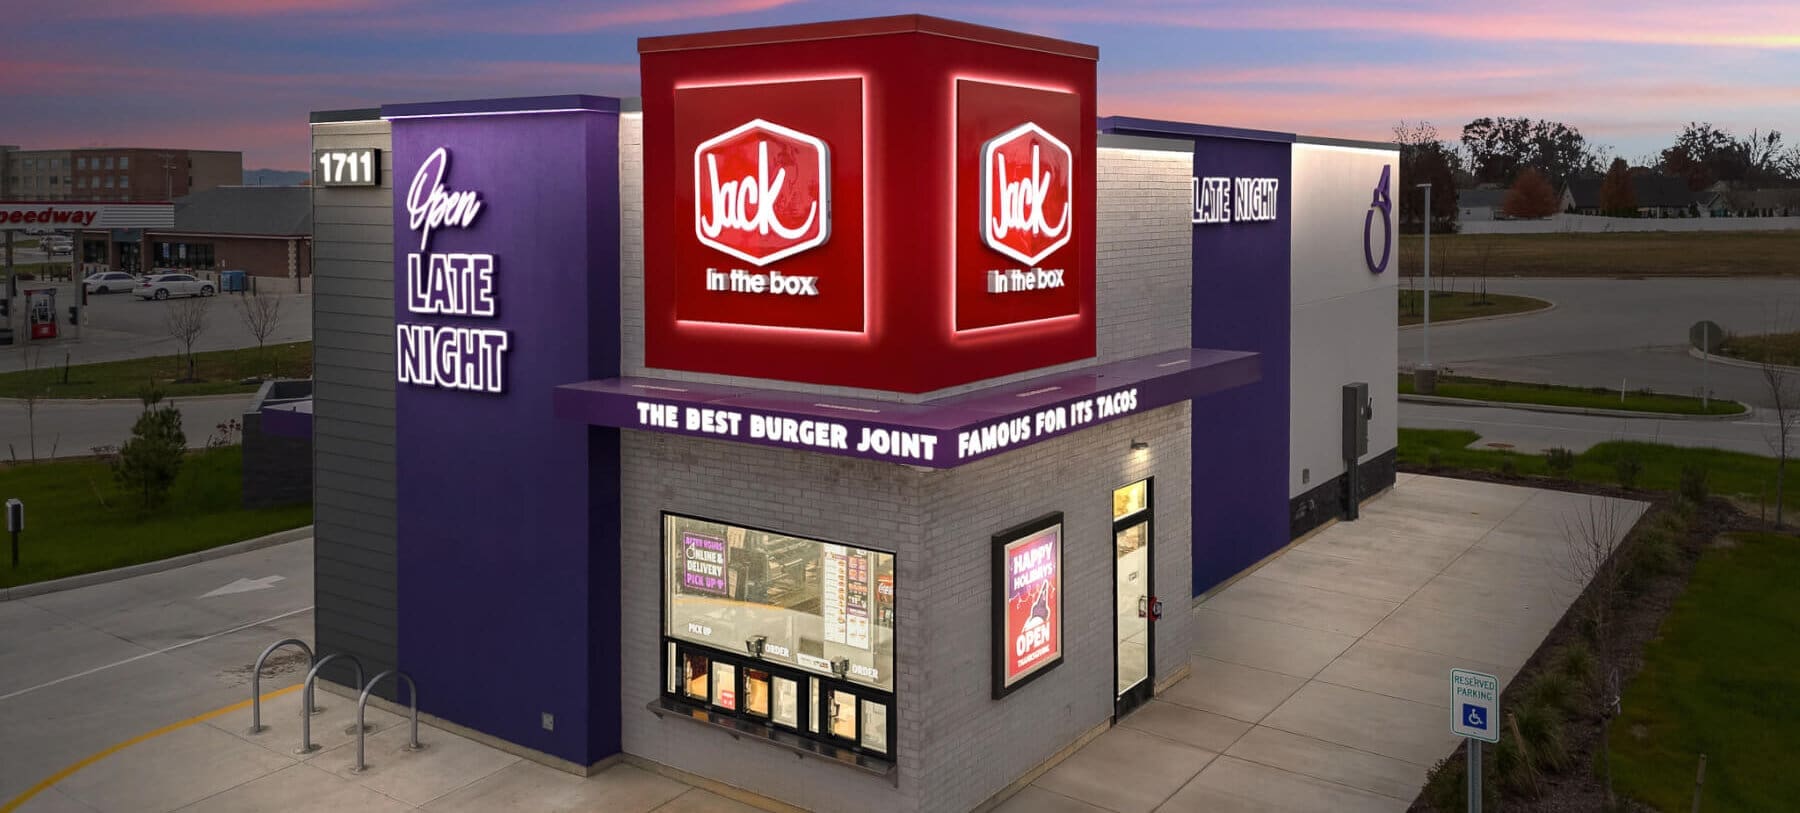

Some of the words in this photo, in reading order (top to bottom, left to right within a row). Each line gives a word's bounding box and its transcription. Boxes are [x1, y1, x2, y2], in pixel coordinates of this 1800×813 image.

[319, 151, 371, 183] 1711
[406, 147, 481, 251] Open
[700, 140, 817, 240] Jack
[992, 144, 1069, 240] Jack
[1191, 177, 1231, 223] LATE
[1234, 177, 1279, 222] NIGHT
[407, 253, 495, 316] LATE
[730, 269, 768, 293] the
[769, 270, 819, 295] box
[1009, 269, 1035, 291] the
[1035, 268, 1065, 289] box
[396, 324, 507, 393] NIGHT
[636, 401, 679, 428] THE
[685, 408, 742, 435] BEST
[750, 414, 849, 450] BURGER
[857, 428, 938, 461] JOINT
[958, 415, 1031, 459] FAMOUS
[1035, 407, 1067, 437] FOR
[1070, 399, 1093, 427] ITS
[1096, 388, 1138, 419] TACOS
[687, 560, 722, 577] DELIVERY
[1013, 542, 1052, 573] HAPPY
[687, 572, 704, 587] PICK
[705, 577, 717, 588] UP
[1014, 563, 1052, 589] HOLIDAYS
[688, 623, 703, 634] PICK
[703, 627, 712, 636] UP
[1016, 622, 1050, 656] OPEN
[765, 643, 790, 658] ORDER
[852, 664, 879, 680] ORDER
[1454, 675, 1494, 690] RESERVED
[1457, 687, 1492, 700] PARKING
